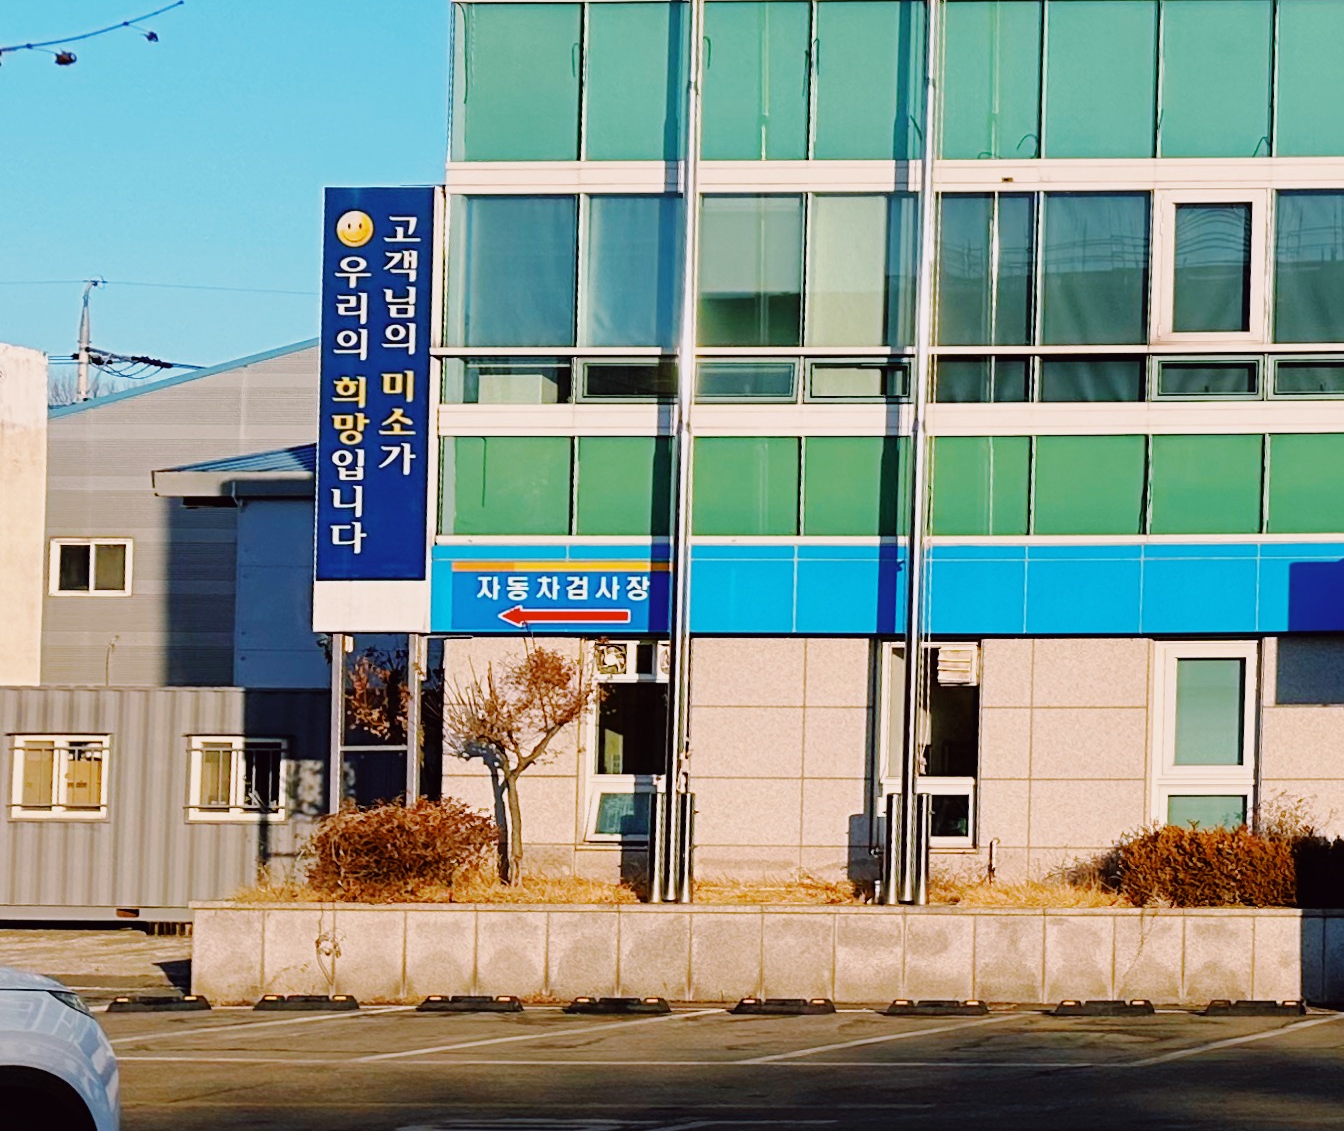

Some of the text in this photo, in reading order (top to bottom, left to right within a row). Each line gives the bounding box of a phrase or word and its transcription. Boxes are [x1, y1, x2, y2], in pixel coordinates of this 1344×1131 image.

[330, 255, 372, 555] 우리의 희망입니다
[378, 215, 421, 476] 고객님의 미소가
[476, 575, 651, 601] 자동차검사장
